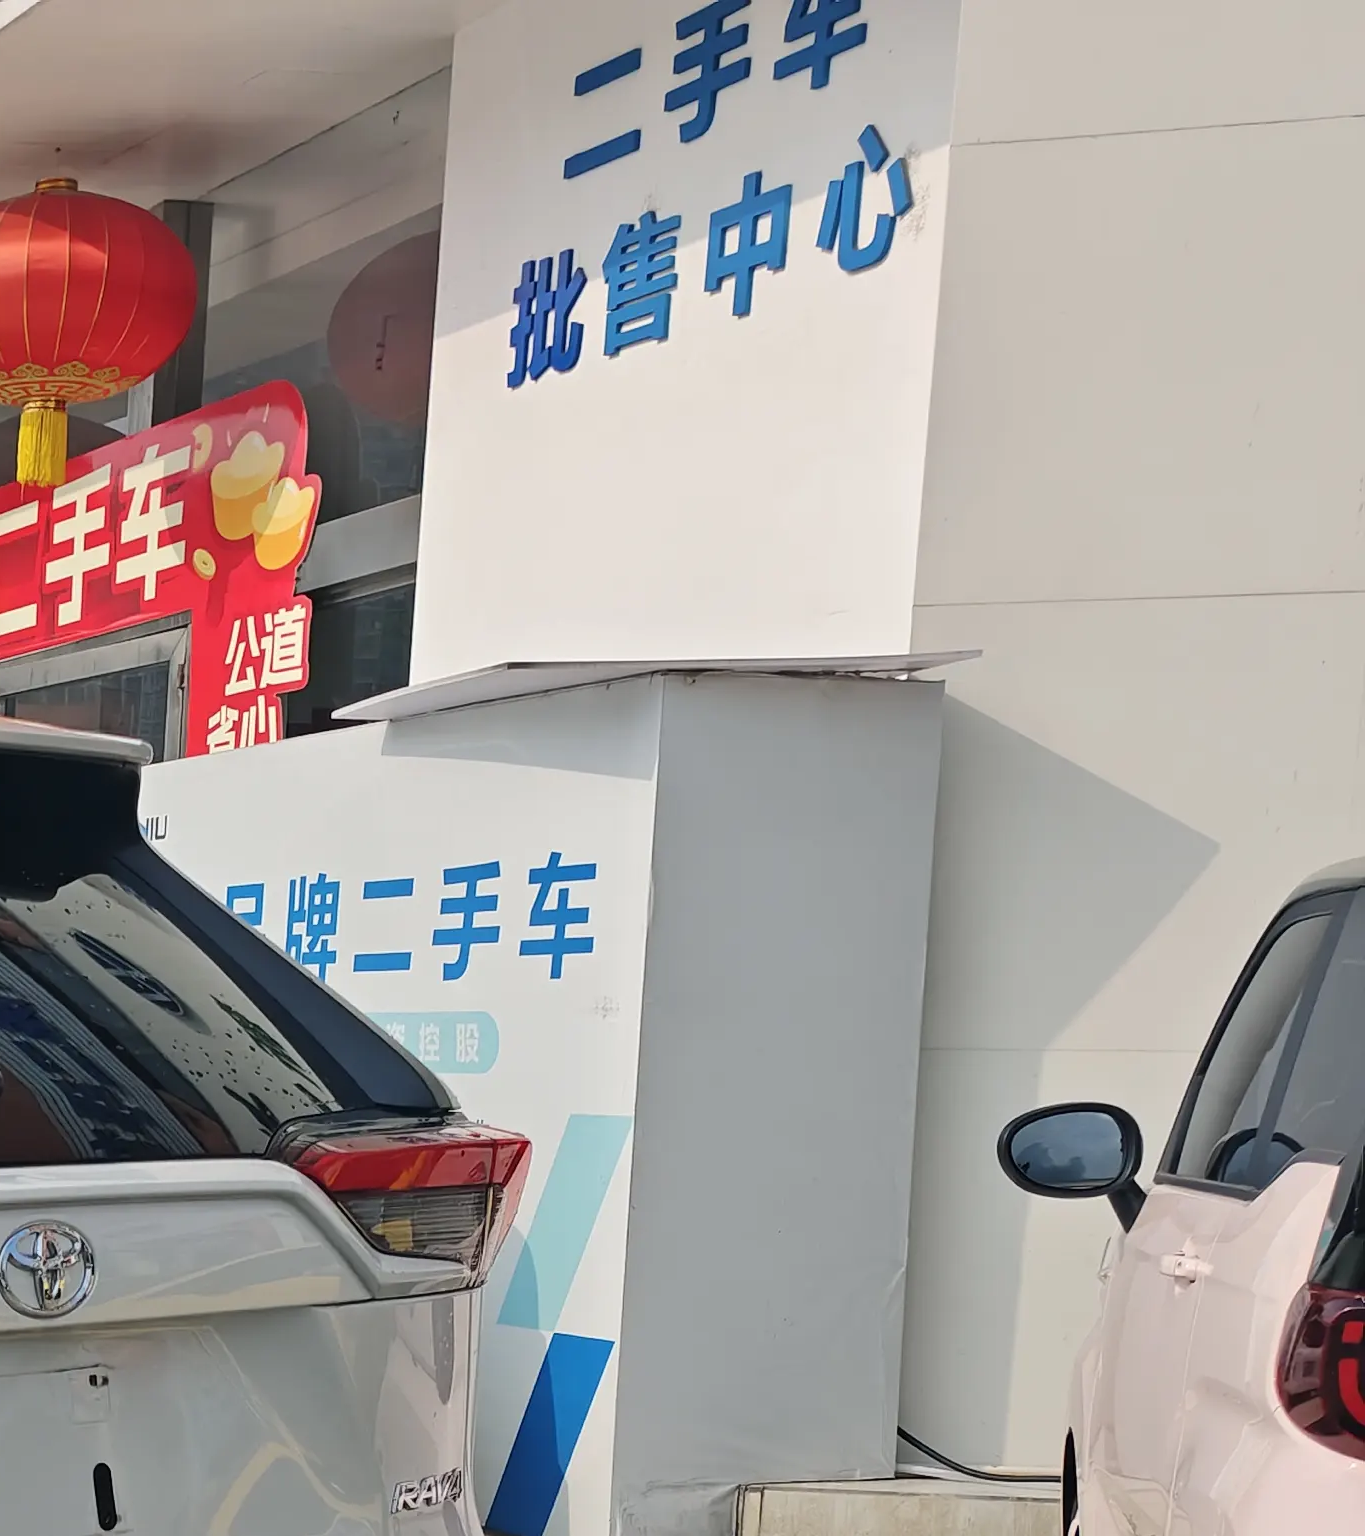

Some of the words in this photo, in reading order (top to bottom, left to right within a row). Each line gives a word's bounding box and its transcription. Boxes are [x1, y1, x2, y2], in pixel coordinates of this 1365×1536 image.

[563, 0, 868, 179] 二手车
[507, 125, 914, 389] 批售中心
[224, 603, 307, 696] 公道
[390, 1467, 462, 1514] RAV4
